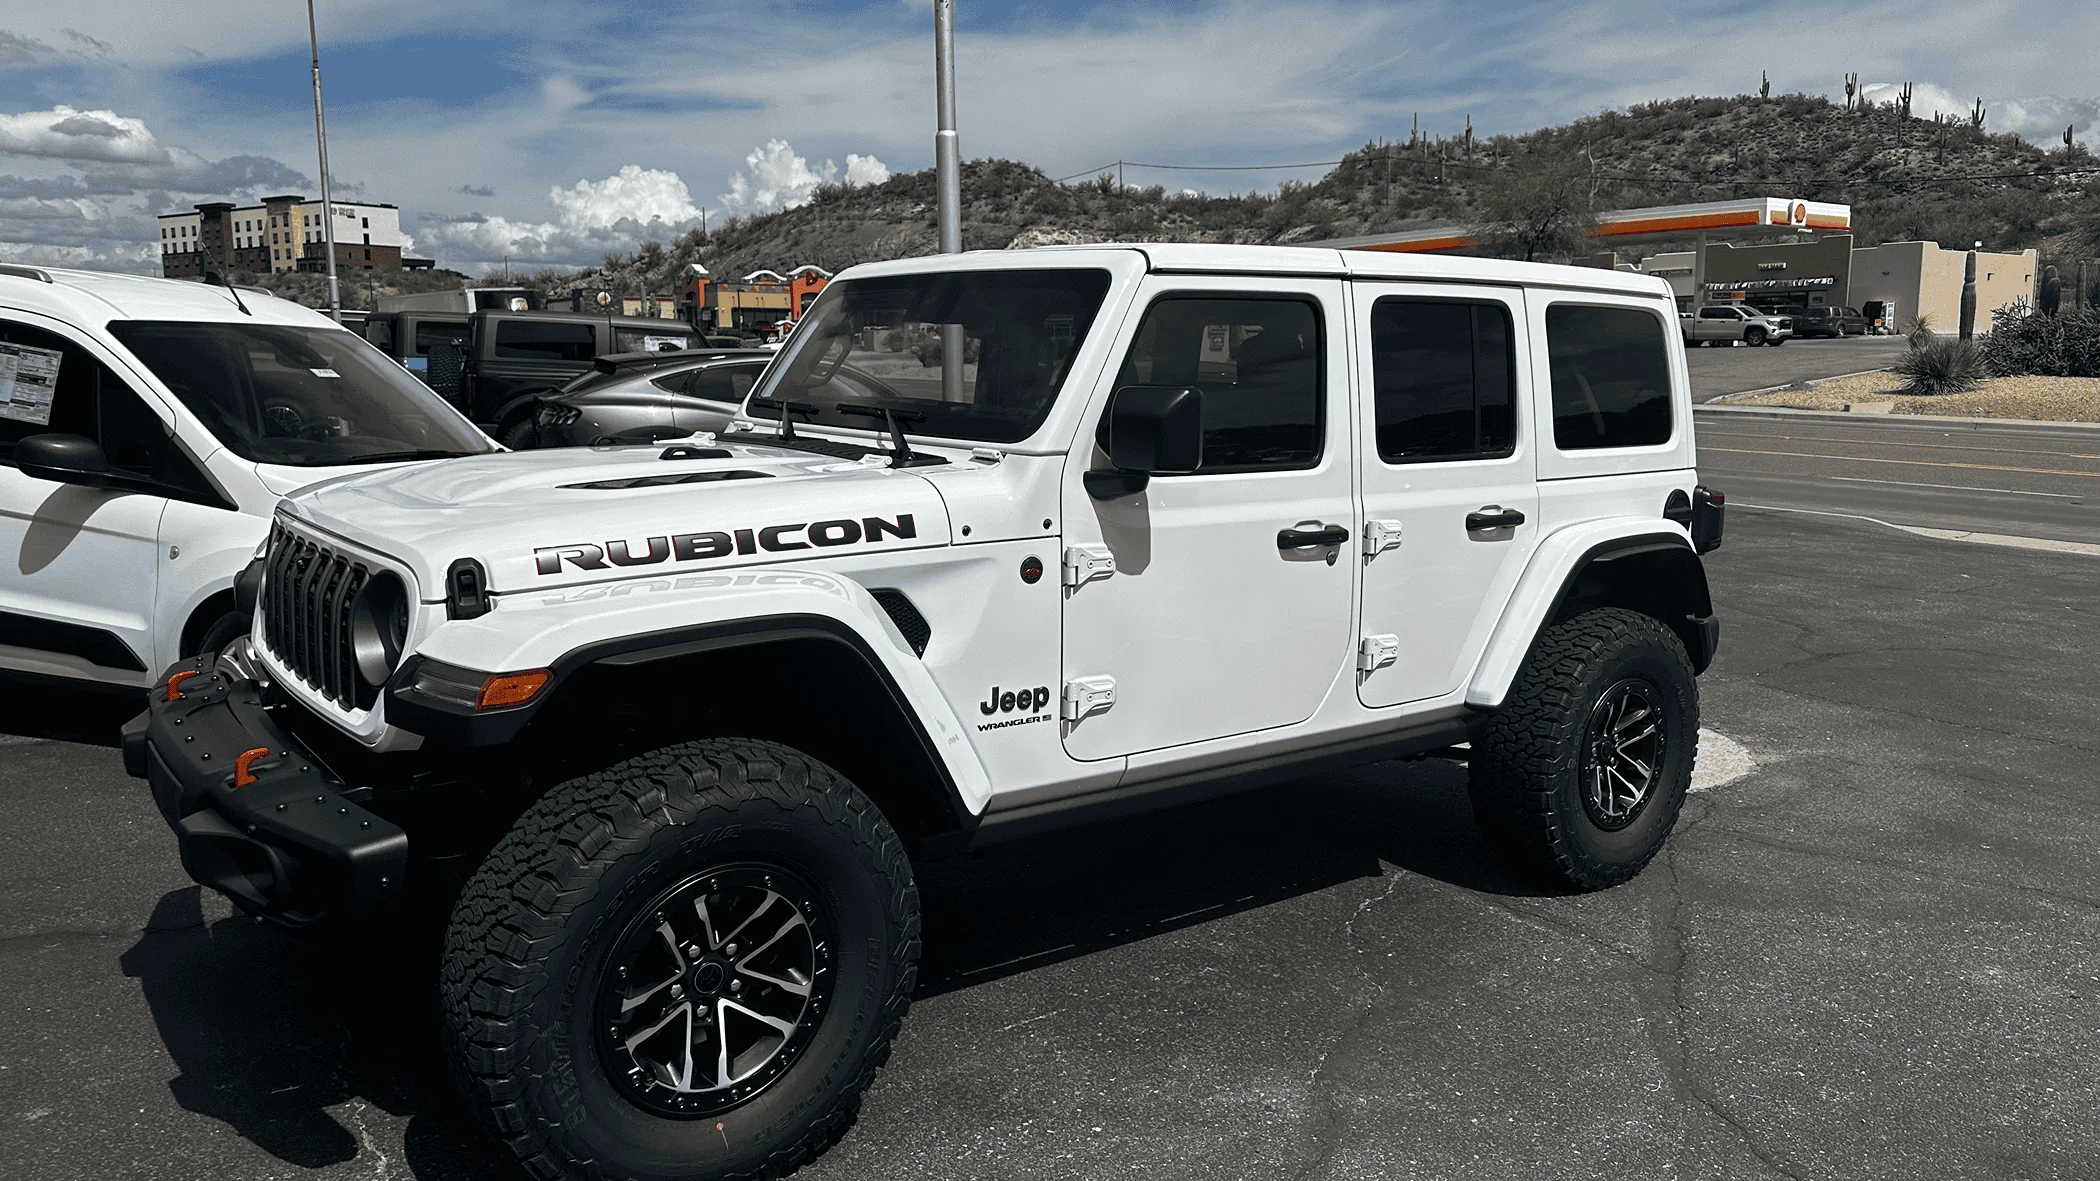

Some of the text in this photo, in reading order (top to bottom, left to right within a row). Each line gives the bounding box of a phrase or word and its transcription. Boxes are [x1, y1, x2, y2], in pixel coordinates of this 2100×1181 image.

[534, 514, 917, 575] RUBICON
[980, 686, 1050, 716] Jeep
[977, 716, 1041, 732] WRANGLER
